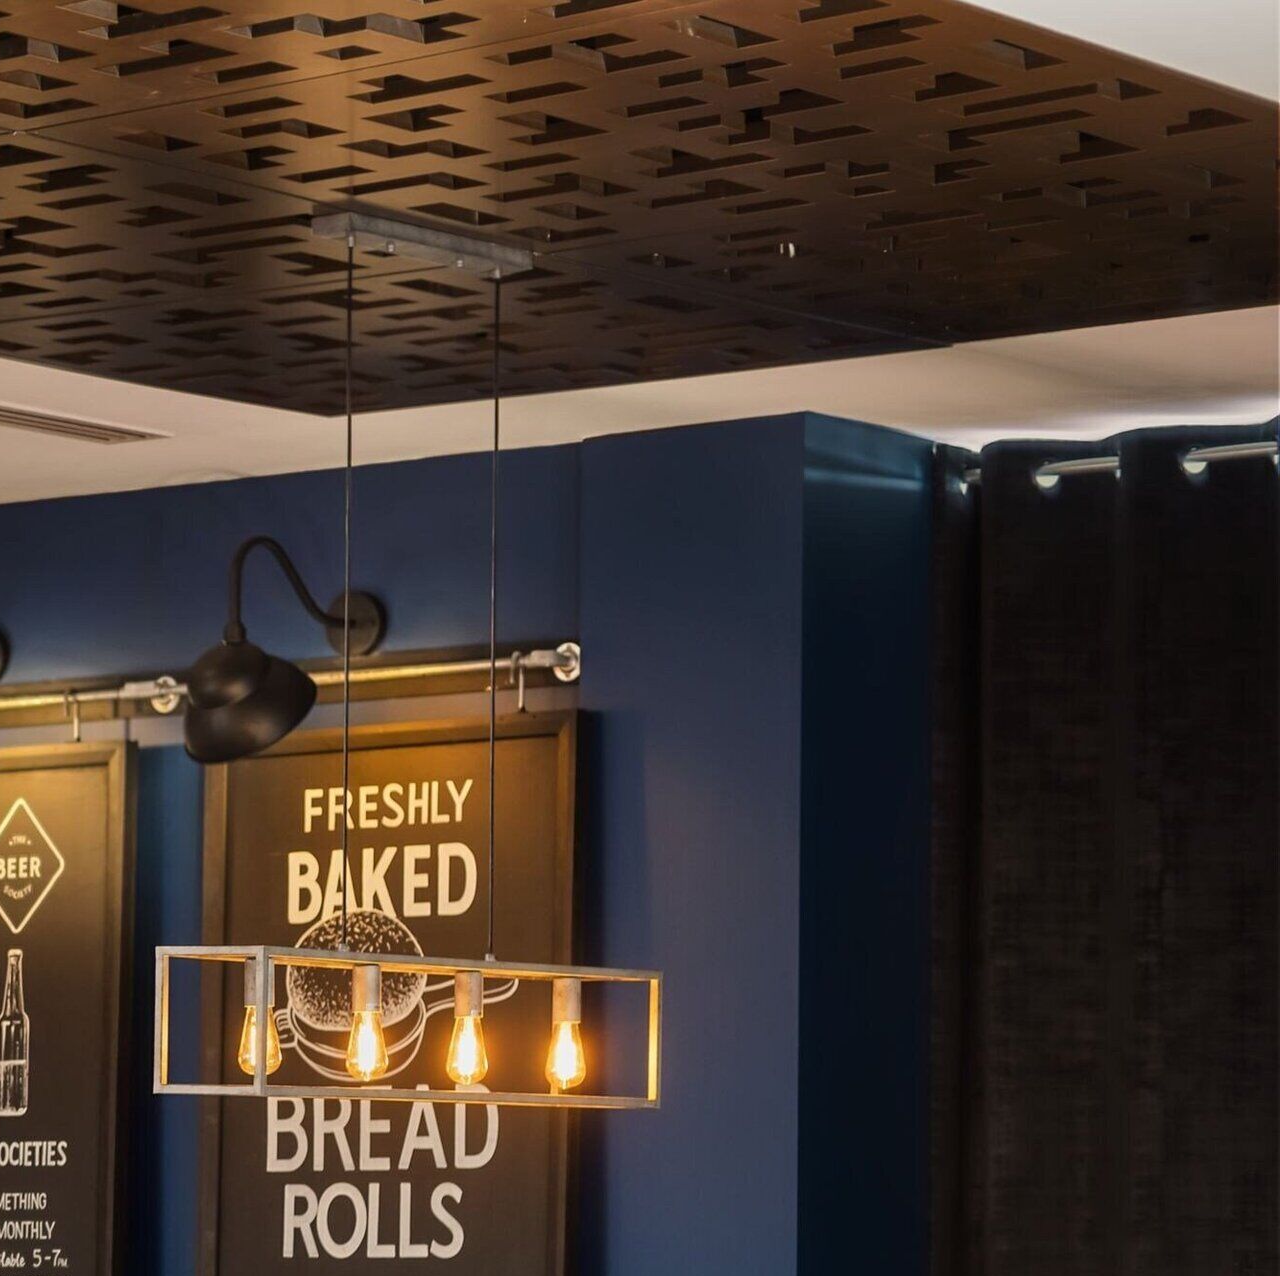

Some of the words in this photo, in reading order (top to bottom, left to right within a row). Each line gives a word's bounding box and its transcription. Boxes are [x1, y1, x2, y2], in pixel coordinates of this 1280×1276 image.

[303, 778, 474, 833] FRESHLY
[3, 884, 32, 900] SOCIETY
[287, 842, 478, 925] BAKED
[266, 1084, 500, 1173] BREAD
[282, 1182, 465, 1259] ROLLS
